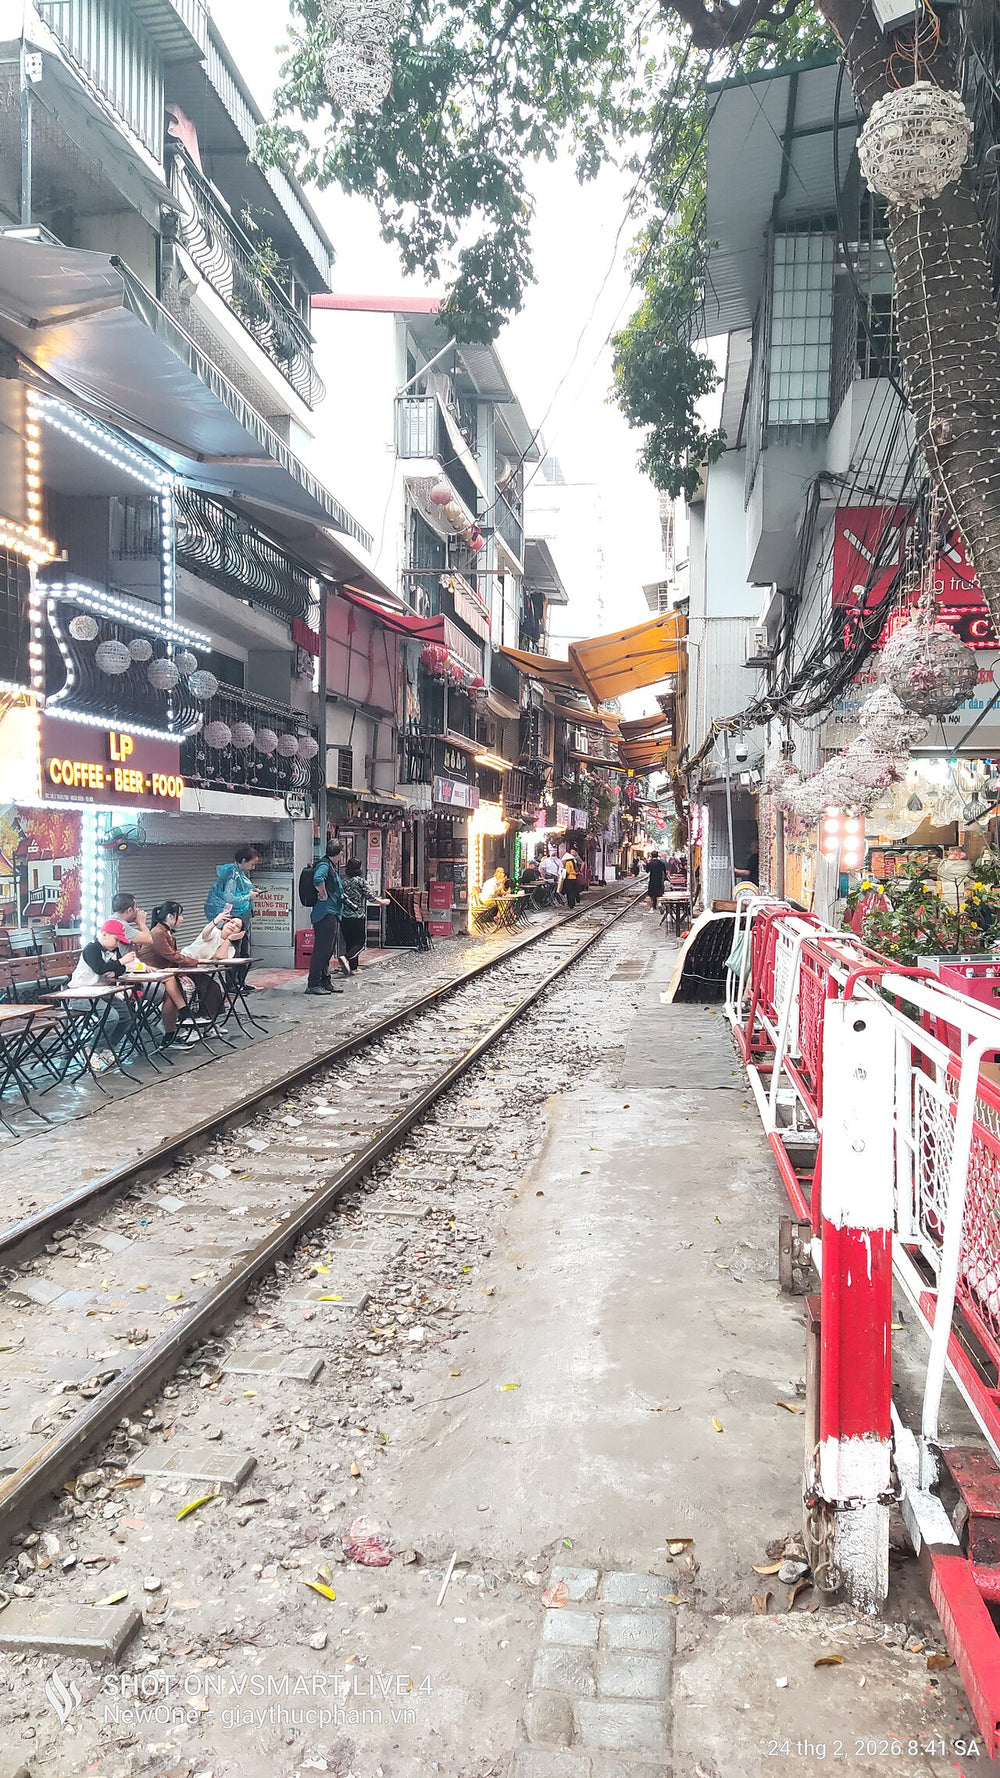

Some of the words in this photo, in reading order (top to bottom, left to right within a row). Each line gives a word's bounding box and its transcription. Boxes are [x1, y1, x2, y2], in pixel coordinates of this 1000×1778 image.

[948, 715, 961, 725] Nội
[109, 731, 134, 762] LP
[49, 757, 105, 789] COFFEE
[114, 767, 144, 794] BEER
[152, 773, 185, 798] FOOD
